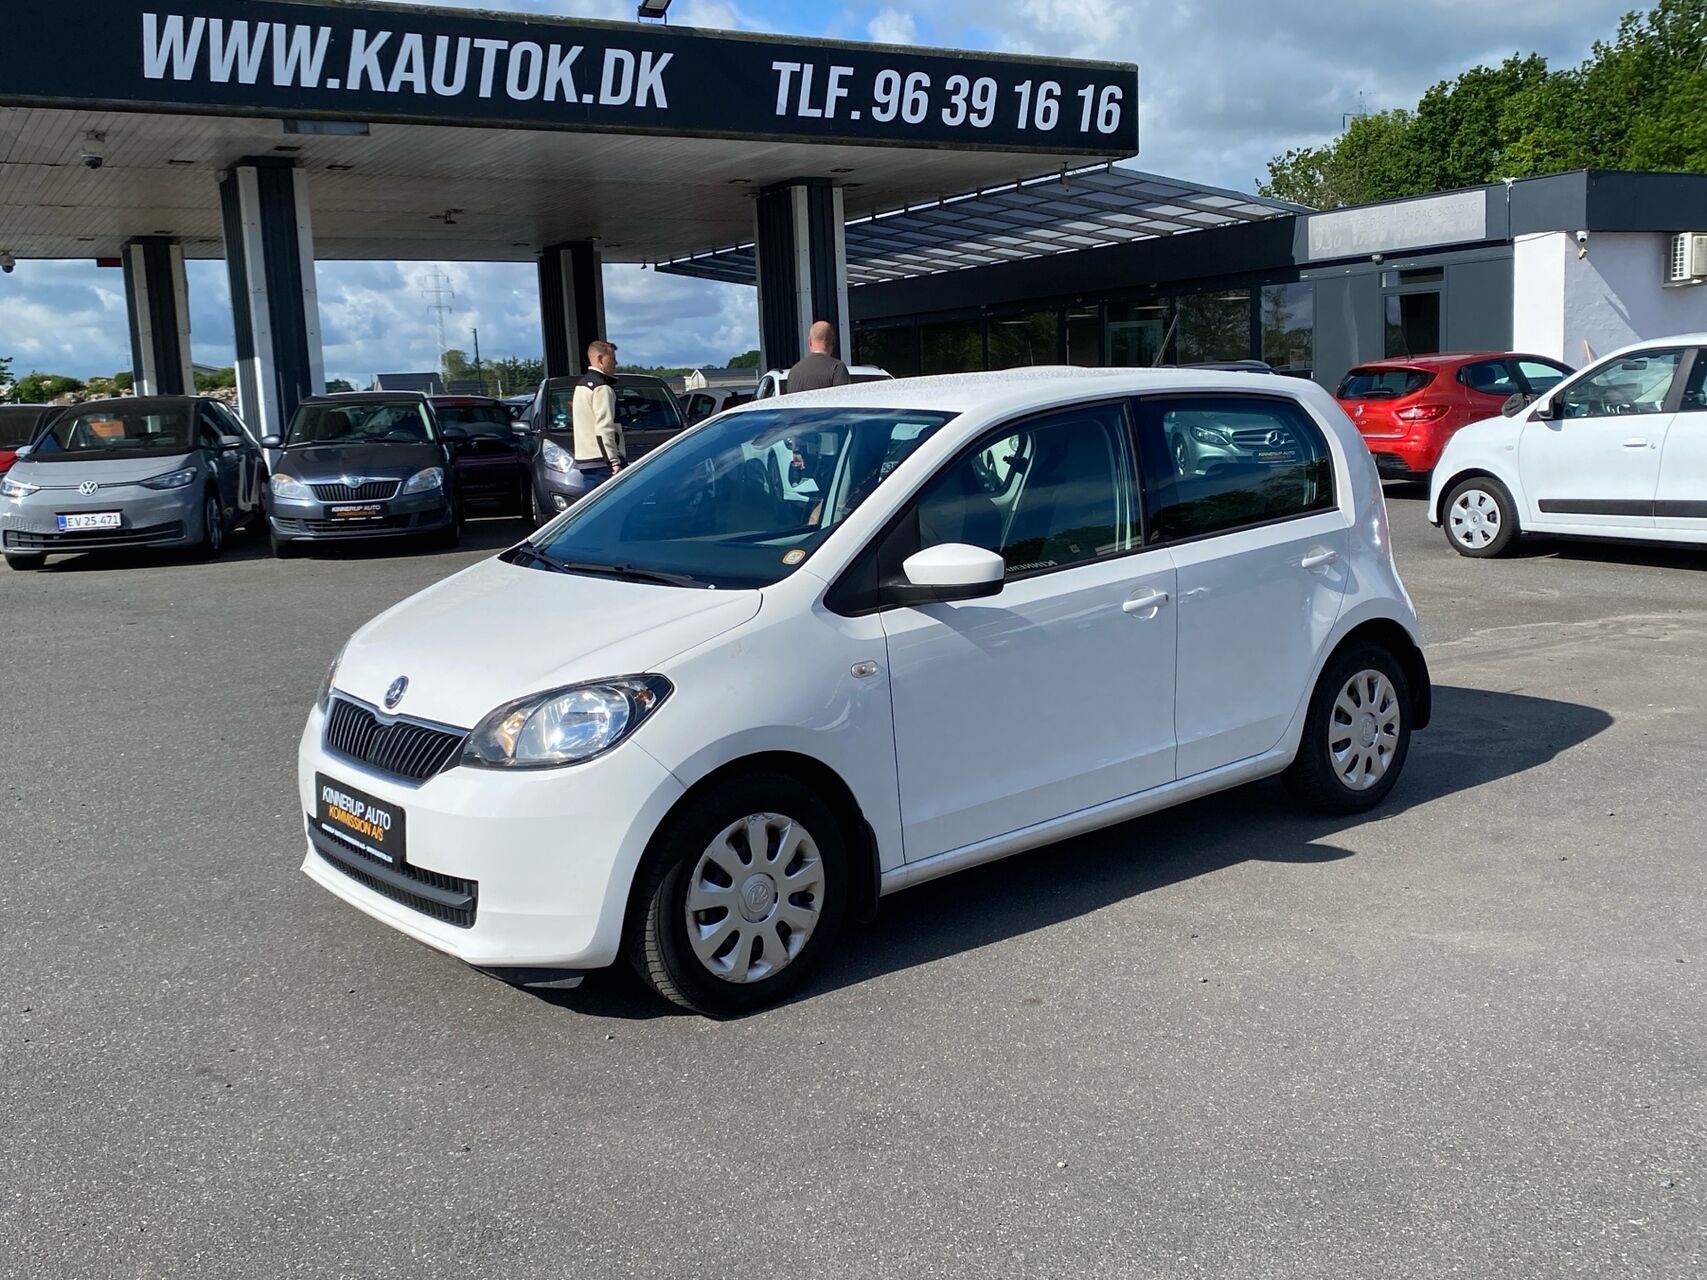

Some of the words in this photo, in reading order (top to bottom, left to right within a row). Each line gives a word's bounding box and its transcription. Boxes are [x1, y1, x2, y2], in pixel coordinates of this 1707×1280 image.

[142, 12, 675, 109] WWW.KAUTOK.DK
[772, 61, 861, 120] TLF.
[872, 69, 931, 124] 96
[941, 75, 998, 128] 39
[1014, 80, 1062, 131] 16
[1077, 84, 1123, 134] 16
[67, 517, 81, 527] EV
[84, 516, 97, 526] 25
[101, 514, 119, 525] 471
[322, 785, 365, 817] KINNERUP
[364, 805, 391, 831] AUTO
[328, 804, 371, 836] KOMMISSION
[370, 827, 384, 841] A/S
